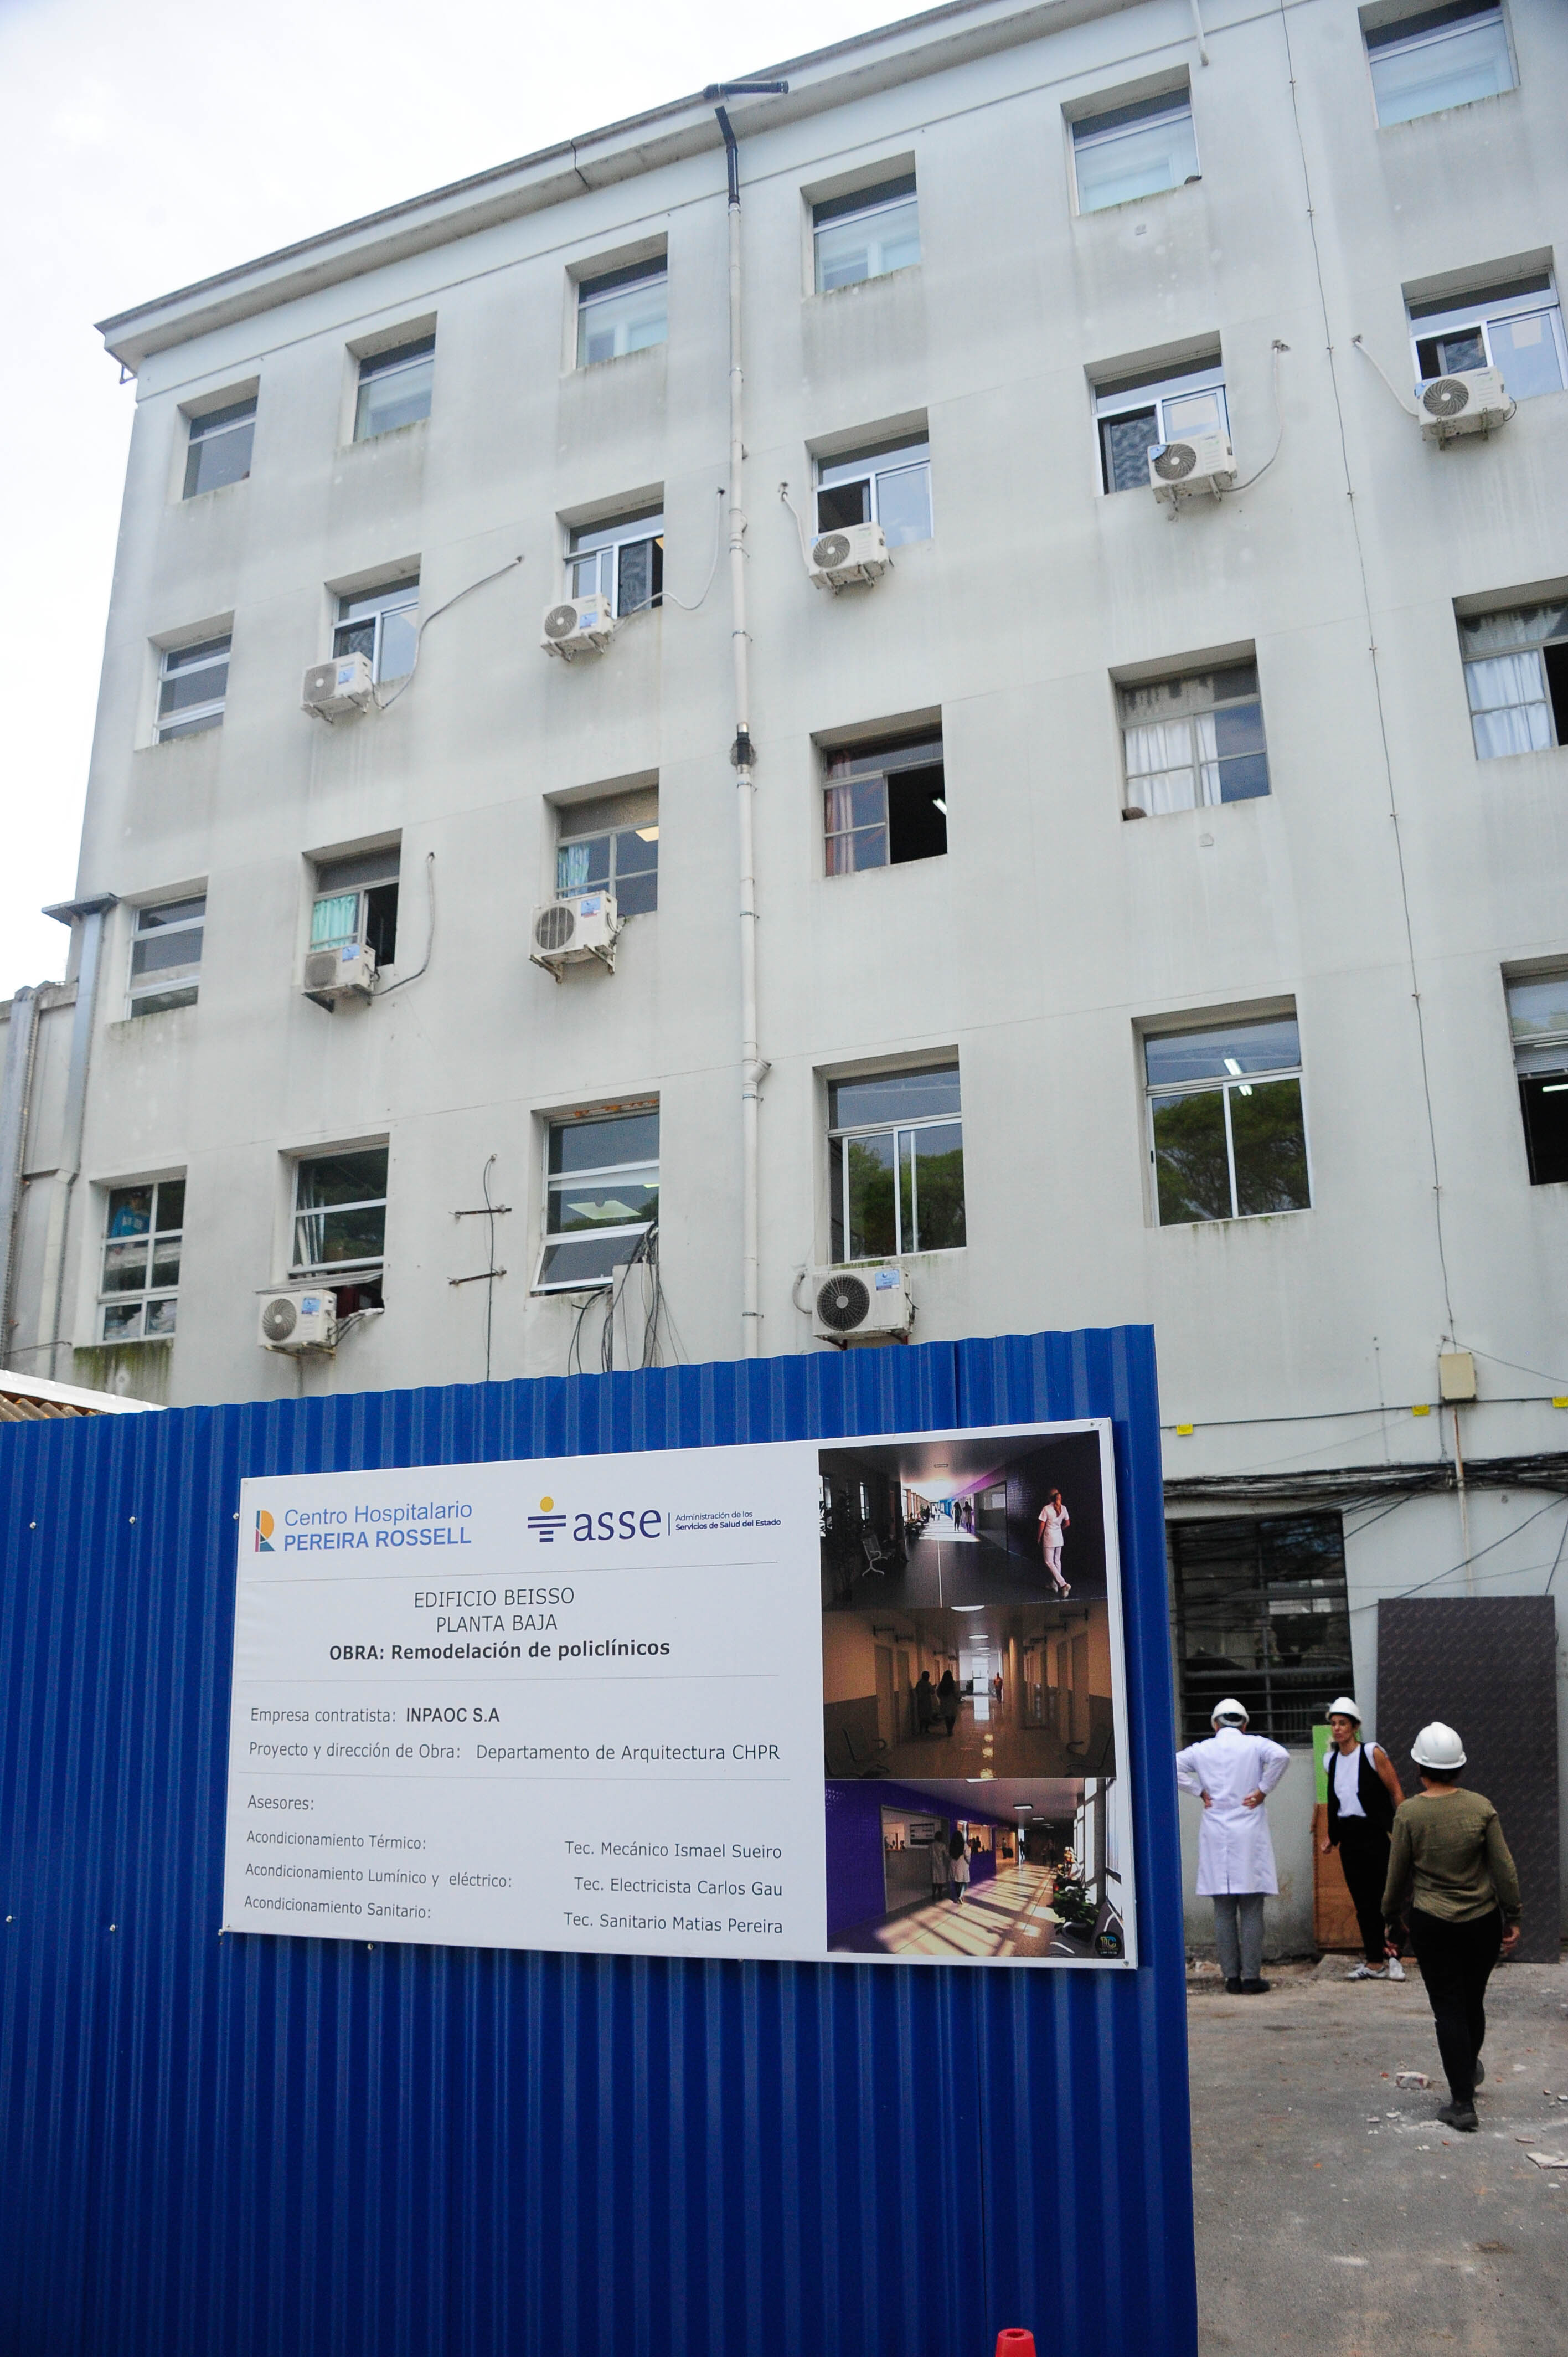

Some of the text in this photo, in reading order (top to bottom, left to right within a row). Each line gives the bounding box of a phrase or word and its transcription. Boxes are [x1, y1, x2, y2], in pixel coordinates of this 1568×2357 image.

[285, 1500, 472, 1526] Centro Hospitalario
[675, 1512, 730, 1521] Administración
[573, 1508, 661, 1542] asse
[675, 1522, 708, 1531] Servicios
[720, 1520, 741, 1529] Salud
[742, 1519, 754, 1527] del
[755, 1518, 781, 1526] Estado
[284, 1526, 472, 1551] PEREIRA ROSSELL
[415, 1587, 574, 1608] EDIFICIO BEISSO
[437, 1614, 558, 1633] PLANTA BAJA
[329, 1638, 670, 1661] OBRA: Remodelación de policlínicos
[251, 1707, 500, 1725] Empresa contratista: INPAOC S.A
[250, 1741, 780, 1764] Proyecto y dirección de Obra: Departamento de Arquitectura CHPR
[247, 1794, 314, 1810] Asesores:
[246, 1830, 426, 1850] Acondicionamiento Térmico:
[564, 1840, 782, 1859] Tec. Mecánico Ismael Sueiro
[245, 1862, 512, 1888] Acondicionamiento Lumínico y eléctrico:
[574, 1876, 782, 1896] Tec. Electricista Carlos Gau
[244, 1895, 431, 1919] Acondicionamiento Sanitario:
[563, 1912, 782, 1934] Tec. Sanitario Matias Pereira
